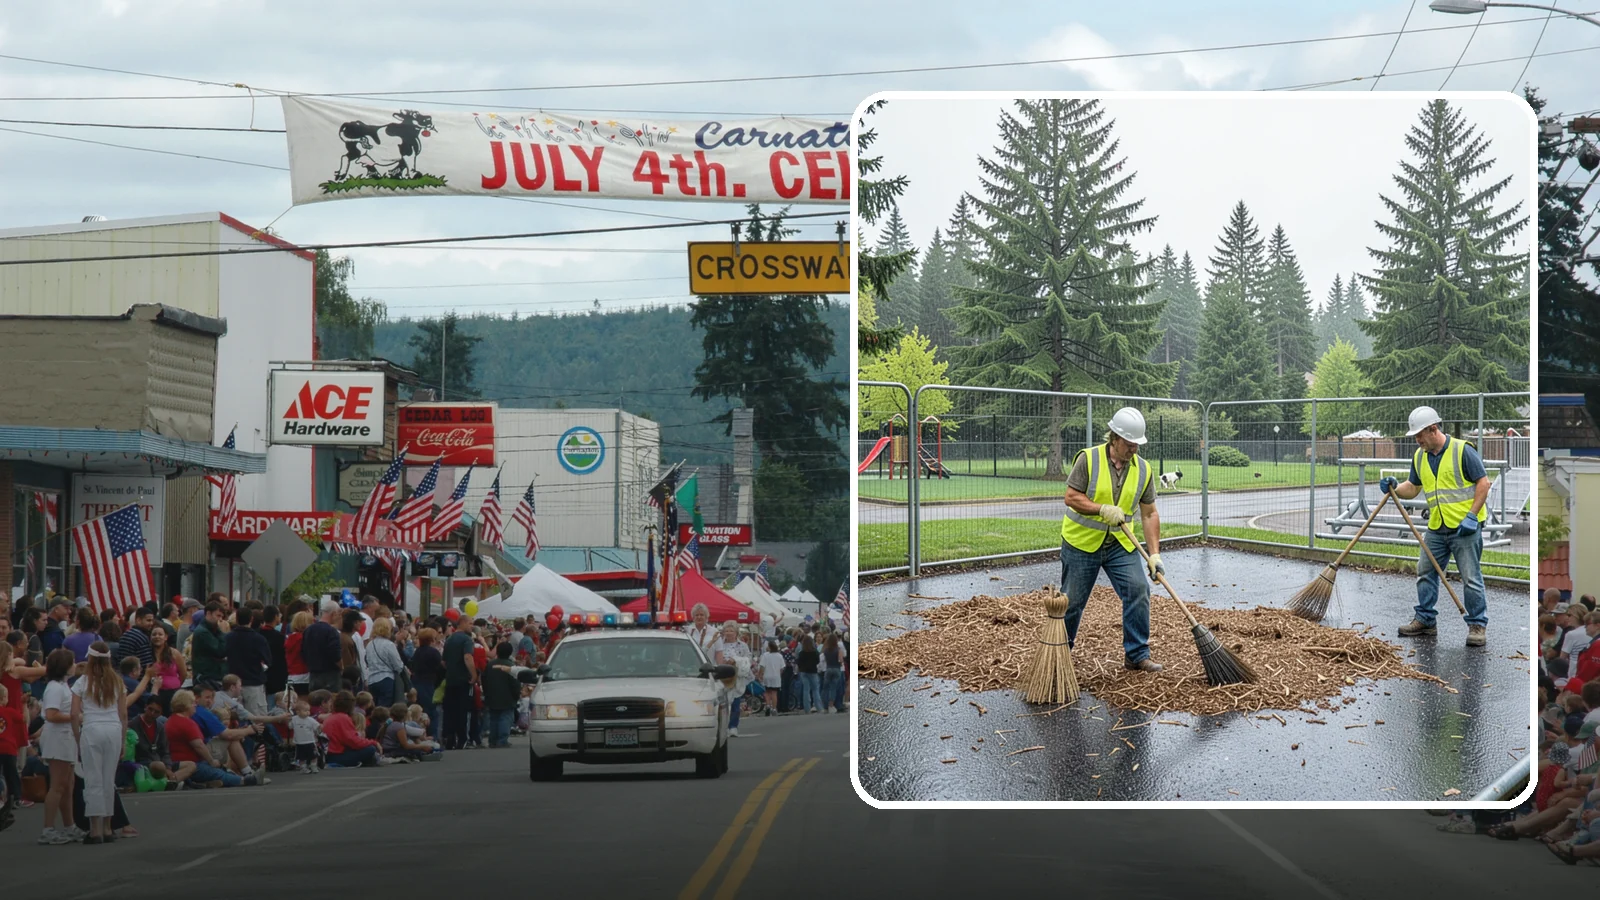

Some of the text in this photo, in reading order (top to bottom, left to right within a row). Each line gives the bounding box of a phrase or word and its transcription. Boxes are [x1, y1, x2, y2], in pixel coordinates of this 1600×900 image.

[481, 141, 605, 193] JULY
[632, 150, 746, 198] 4th.
[697, 254, 850, 280] CROSSWA
[283, 380, 373, 420] ACE
[405, 409, 453, 422] CEDAR
[283, 420, 371, 437] Hardware
[95, 485, 124, 495] Vincent
[126, 485, 136, 495] de
[137, 486, 155, 495] Paul
[699, 535, 730, 543] GLASS
